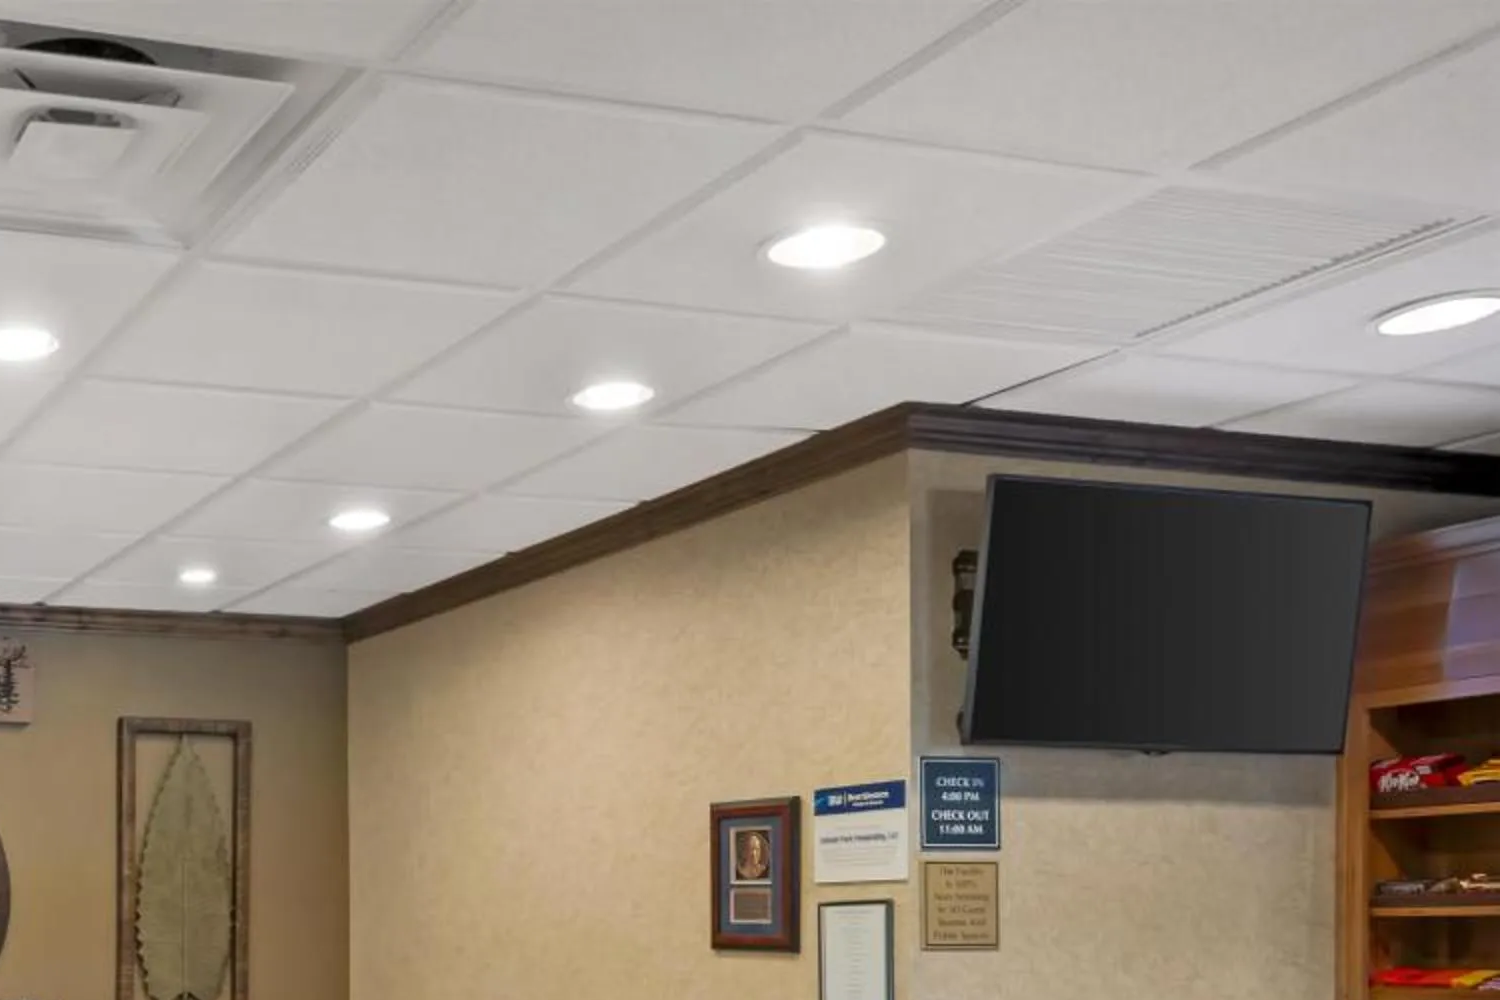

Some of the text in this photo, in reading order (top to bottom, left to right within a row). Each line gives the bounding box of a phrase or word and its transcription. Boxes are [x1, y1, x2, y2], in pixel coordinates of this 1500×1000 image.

[935, 776, 970, 788] CHECK
[963, 791, 980, 801] PM
[931, 809, 990, 821] CHECK OUT
